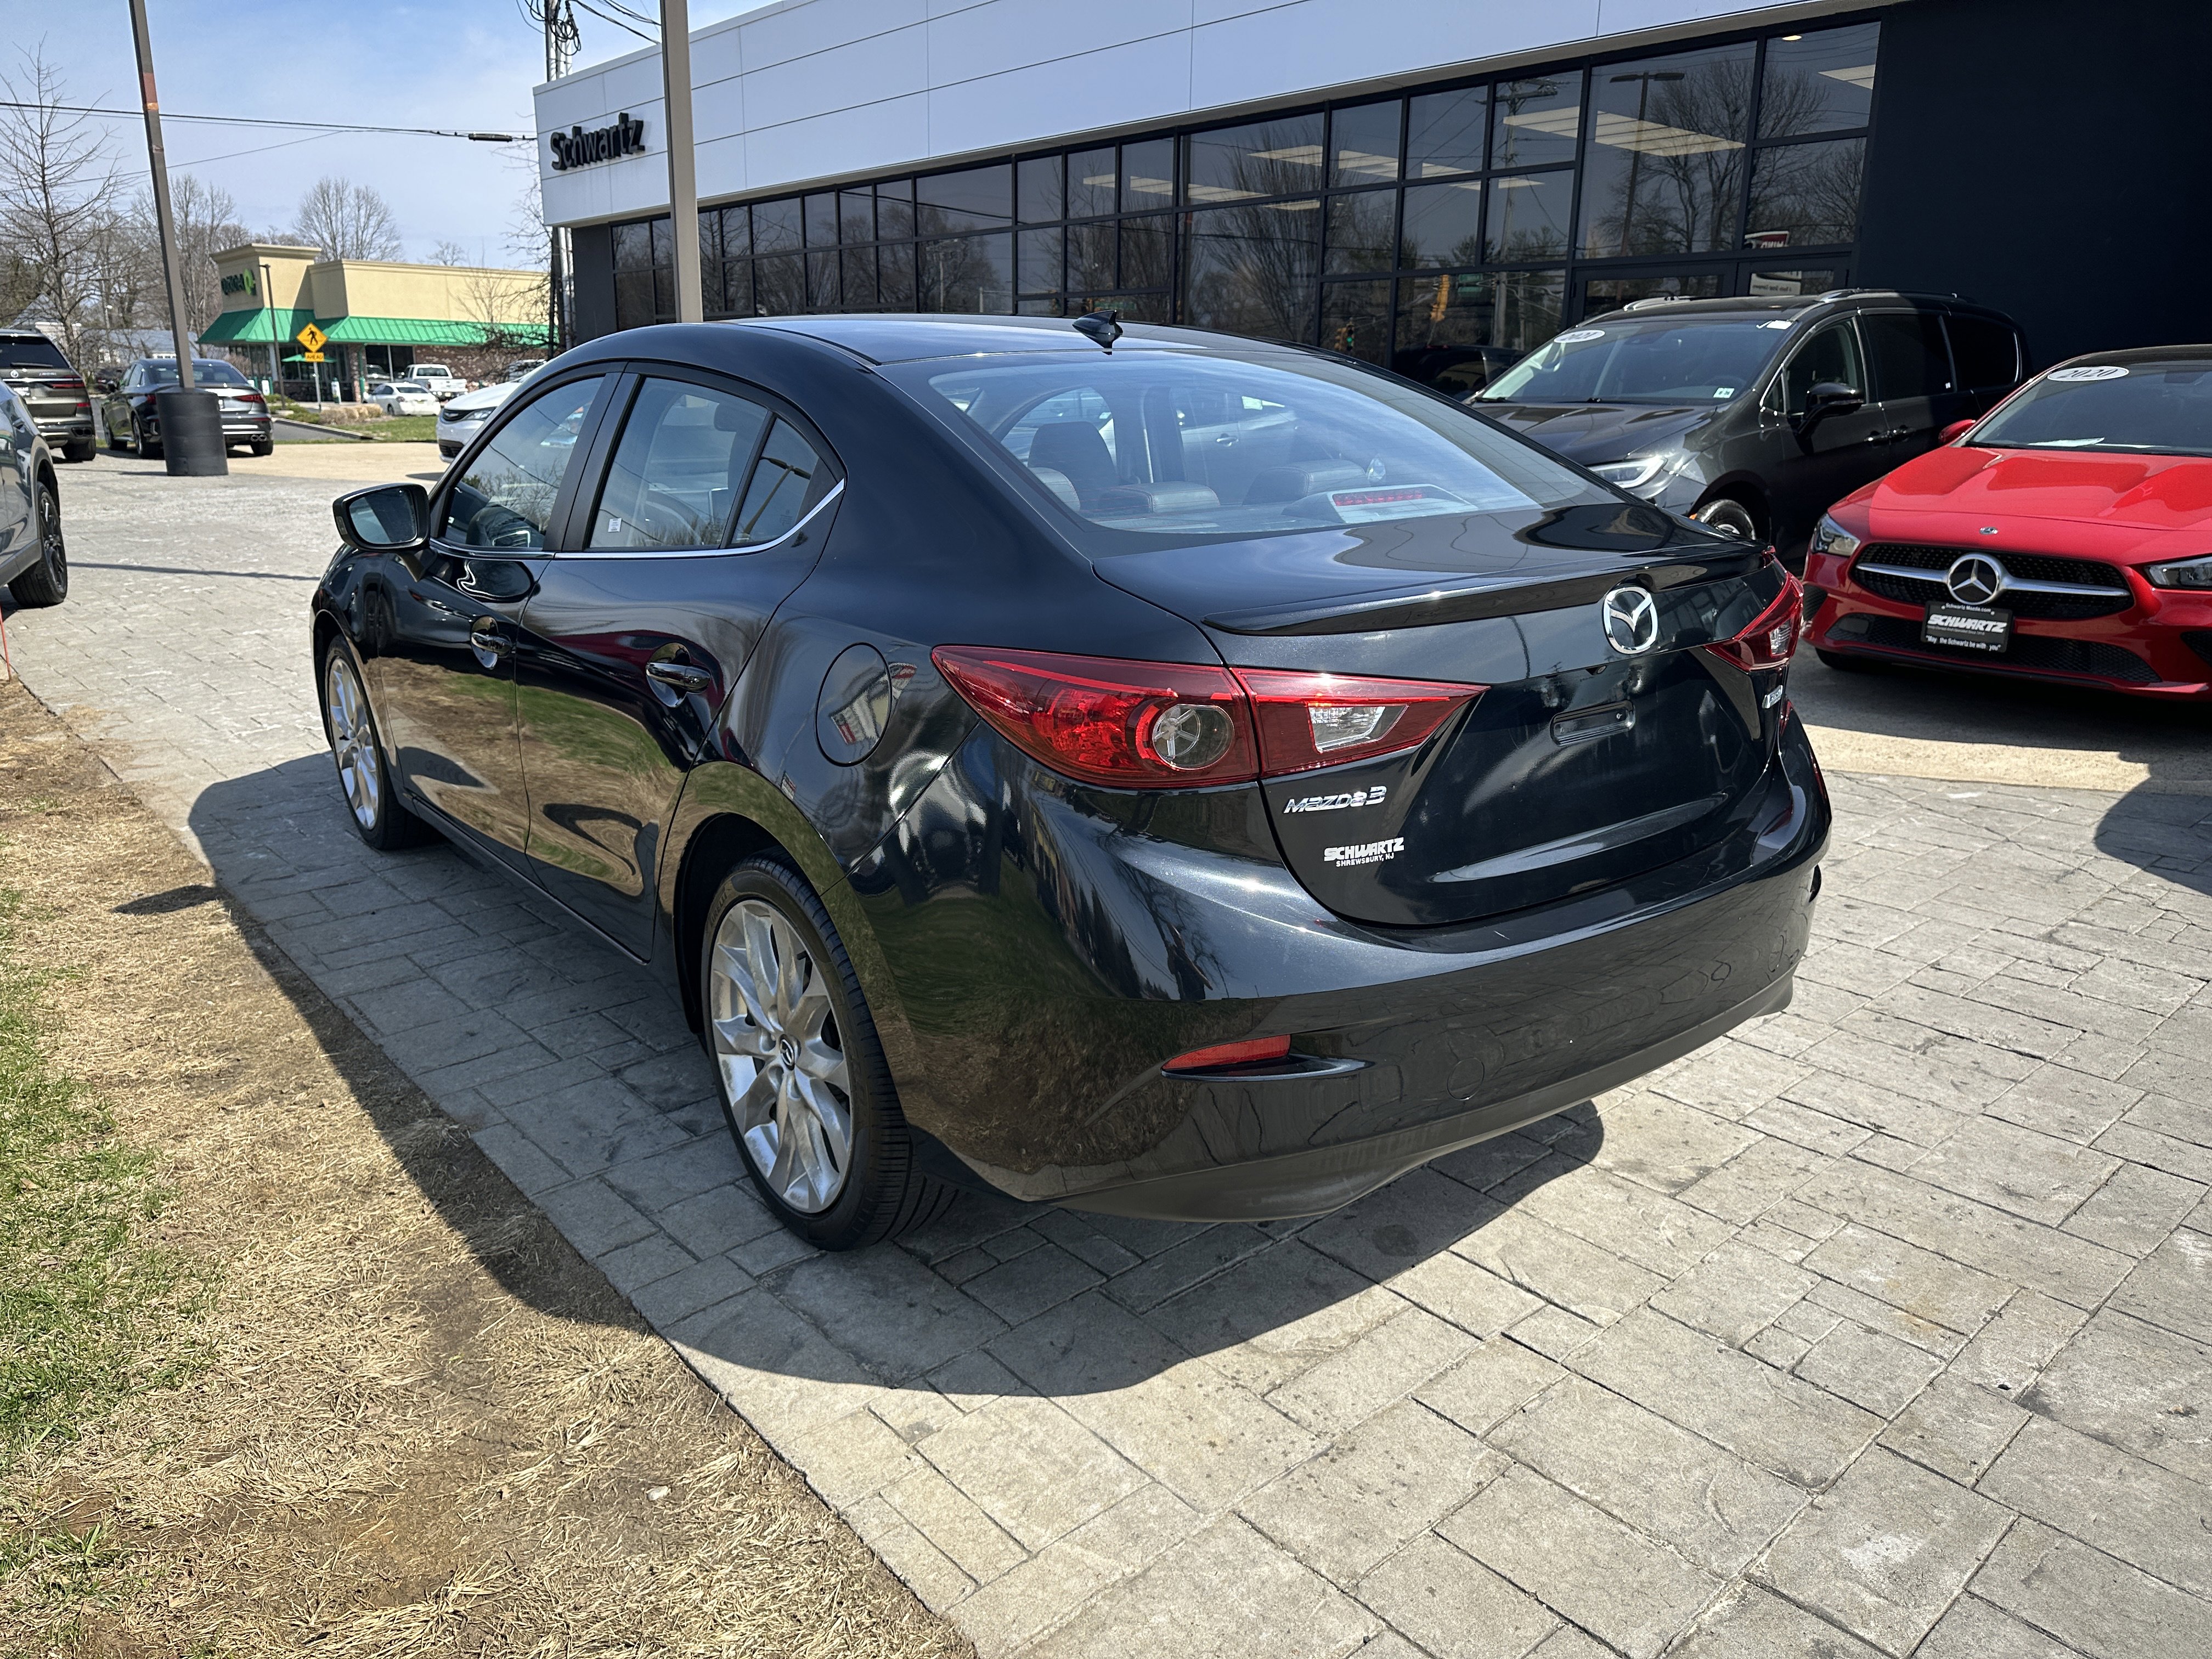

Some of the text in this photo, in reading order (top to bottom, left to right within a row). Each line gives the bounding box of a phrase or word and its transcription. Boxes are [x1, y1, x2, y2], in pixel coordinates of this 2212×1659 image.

[550, 112, 645, 170] Schwartz
[2058, 368, 2119, 379] 2020
[1927, 613, 2007, 633] SCHWARTZ
[1947, 637, 1969, 647] Schwartz
[1323, 837, 1404, 862] SCHWARTZ
[1336, 852, 1395, 868] SHREWSBURY, NJ
